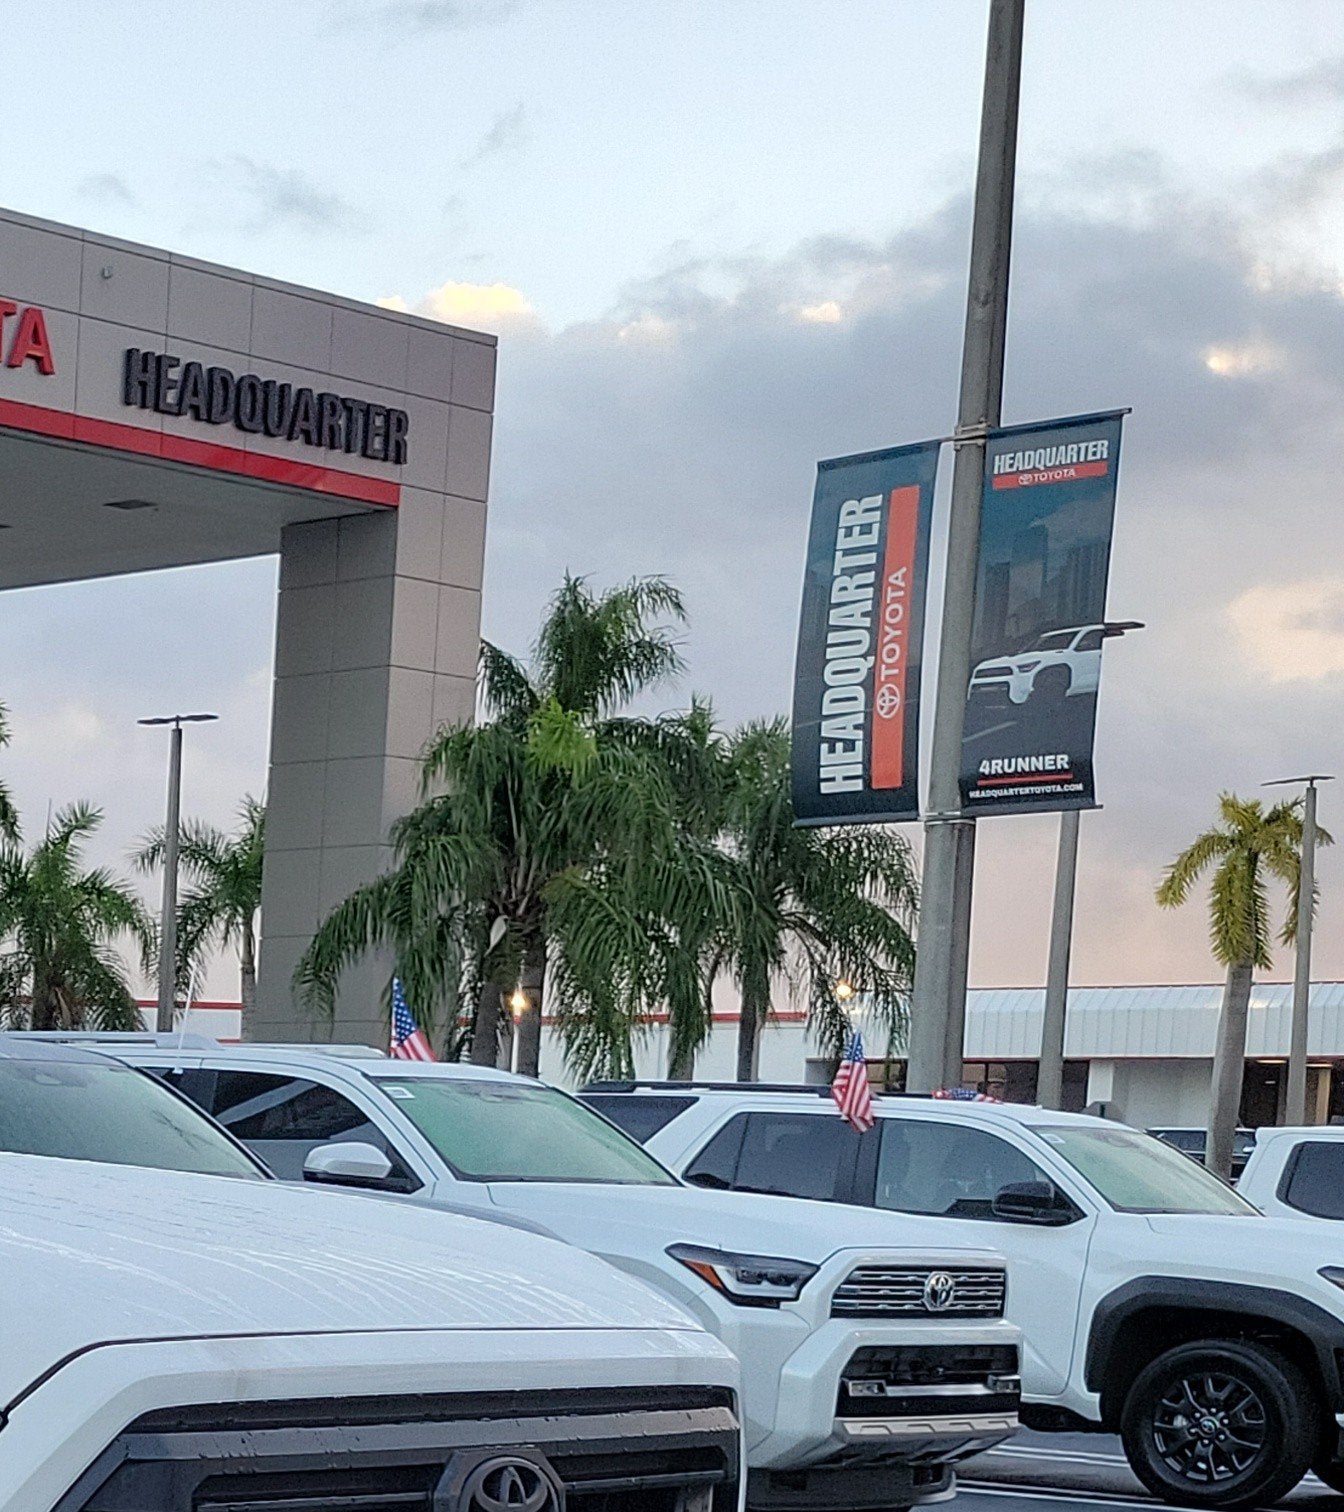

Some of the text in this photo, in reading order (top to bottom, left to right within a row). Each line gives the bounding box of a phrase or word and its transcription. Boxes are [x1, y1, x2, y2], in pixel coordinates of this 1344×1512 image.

[123, 346, 409, 465] HEADQUARTER
[993, 439, 1109, 475] HEADQUARTER
[1033, 468, 1076, 483] TOYOTA
[819, 493, 884, 795] HEADQUARTER
[879, 566, 907, 681] TOYOTA
[979, 754, 1070, 775] 4RUNNER
